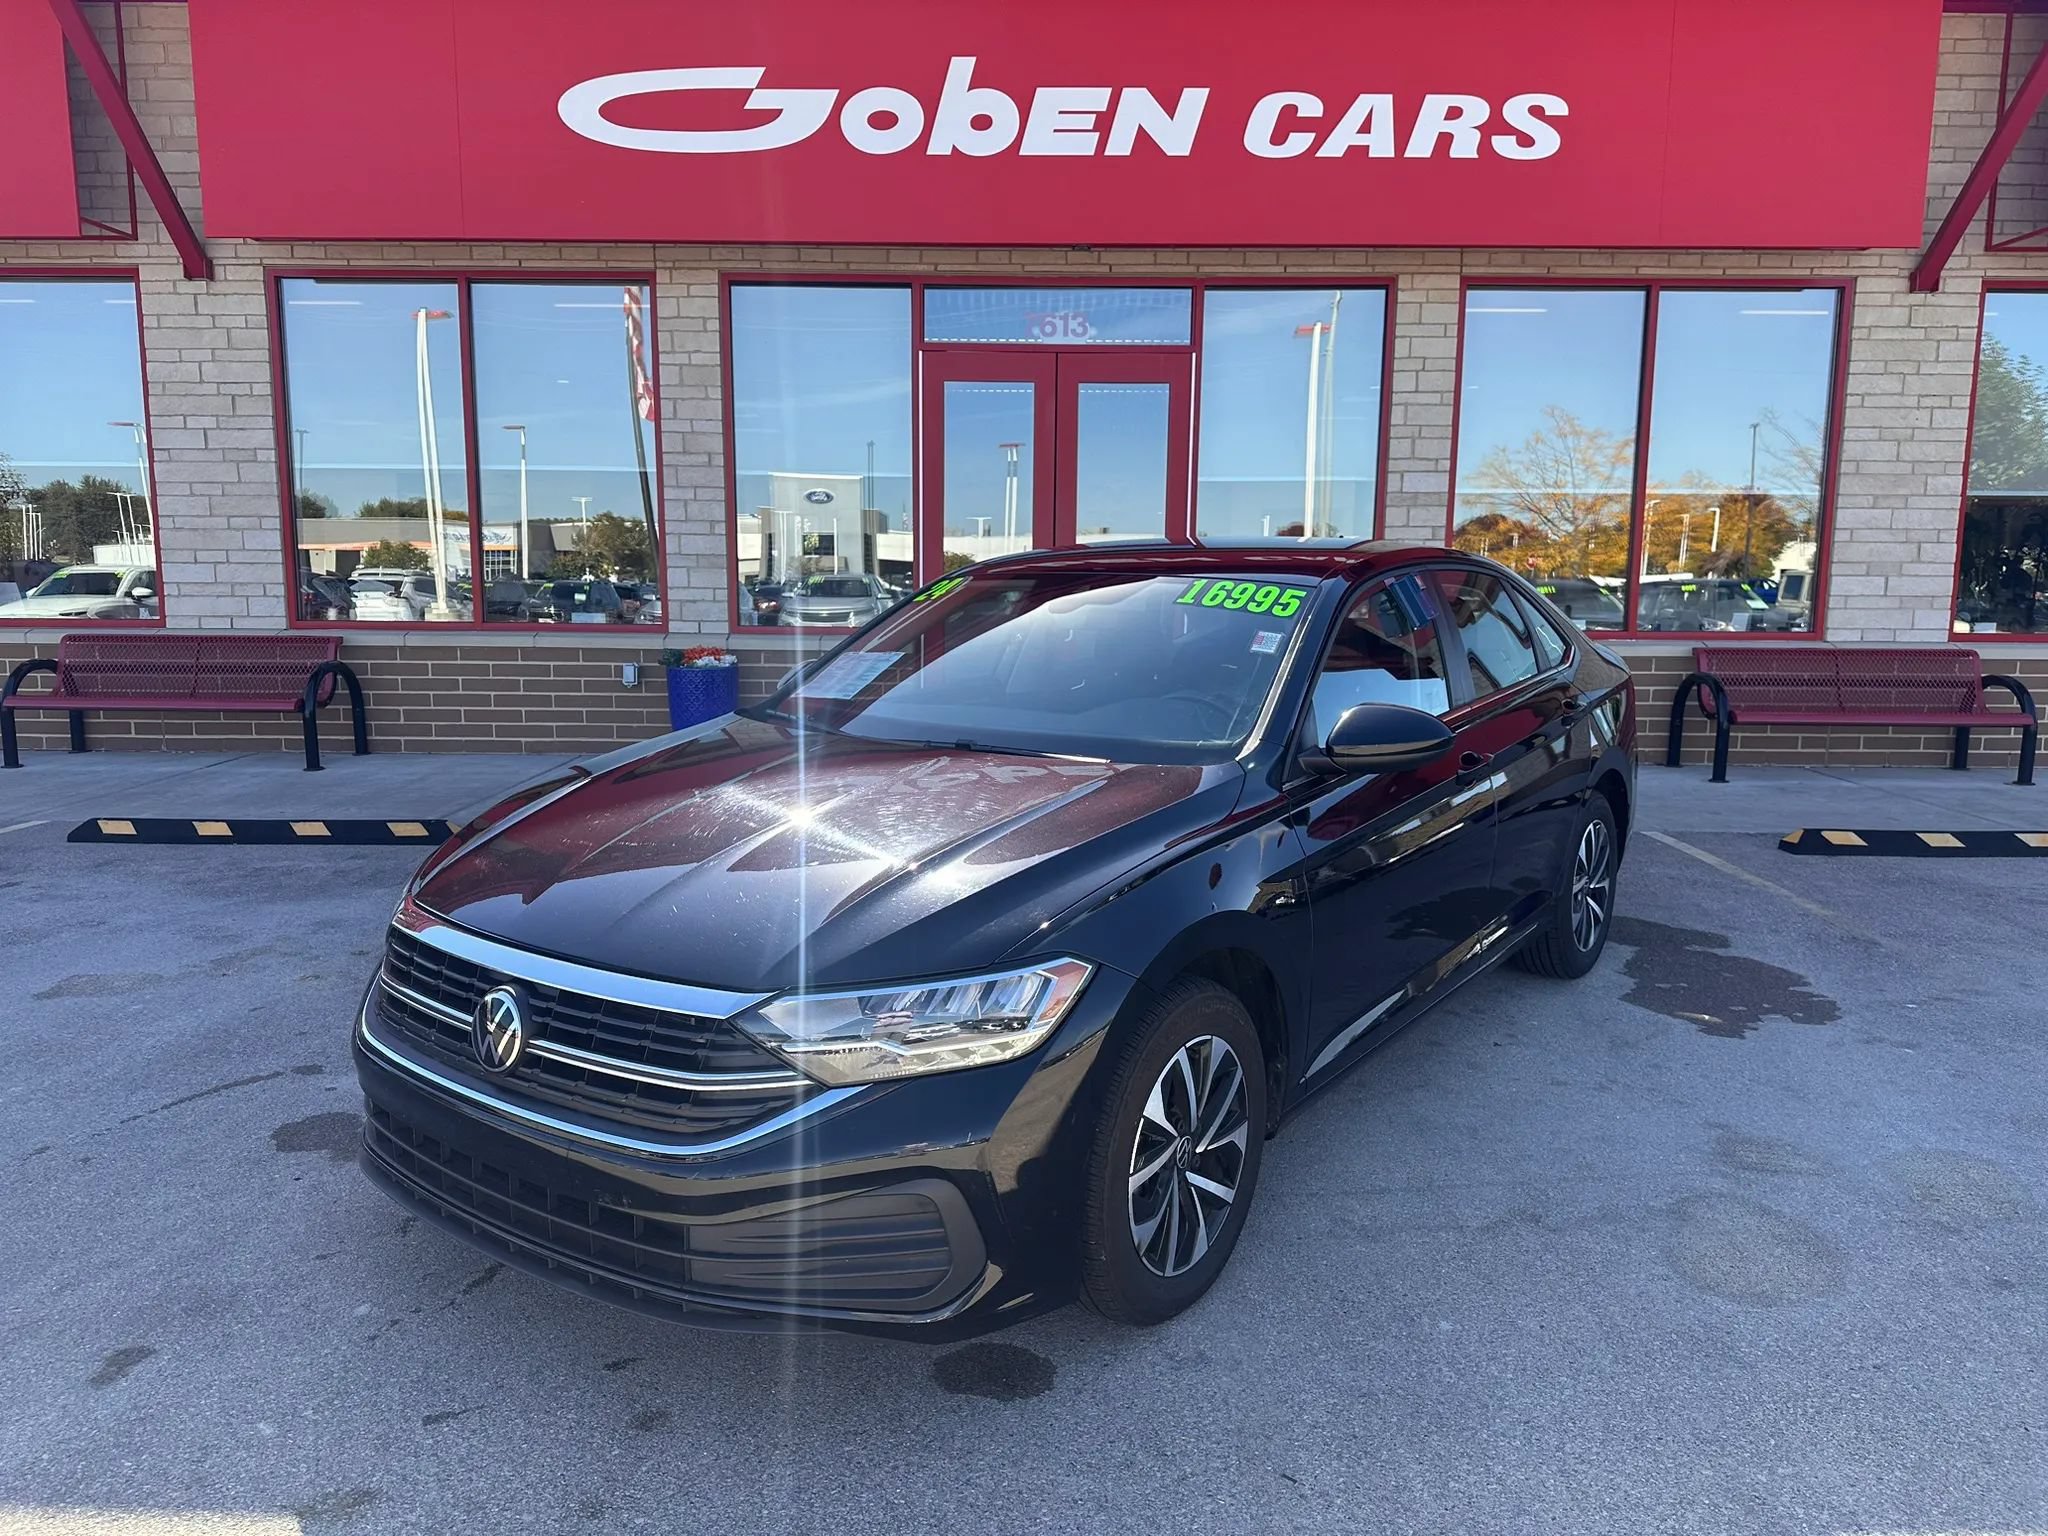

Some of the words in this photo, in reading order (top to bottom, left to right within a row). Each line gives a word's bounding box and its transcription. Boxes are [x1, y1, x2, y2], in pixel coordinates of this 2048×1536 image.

[1244, 91, 1569, 160] CARS
[1040, 312, 1089, 338] 613
[1176, 579, 1307, 617] 16995
